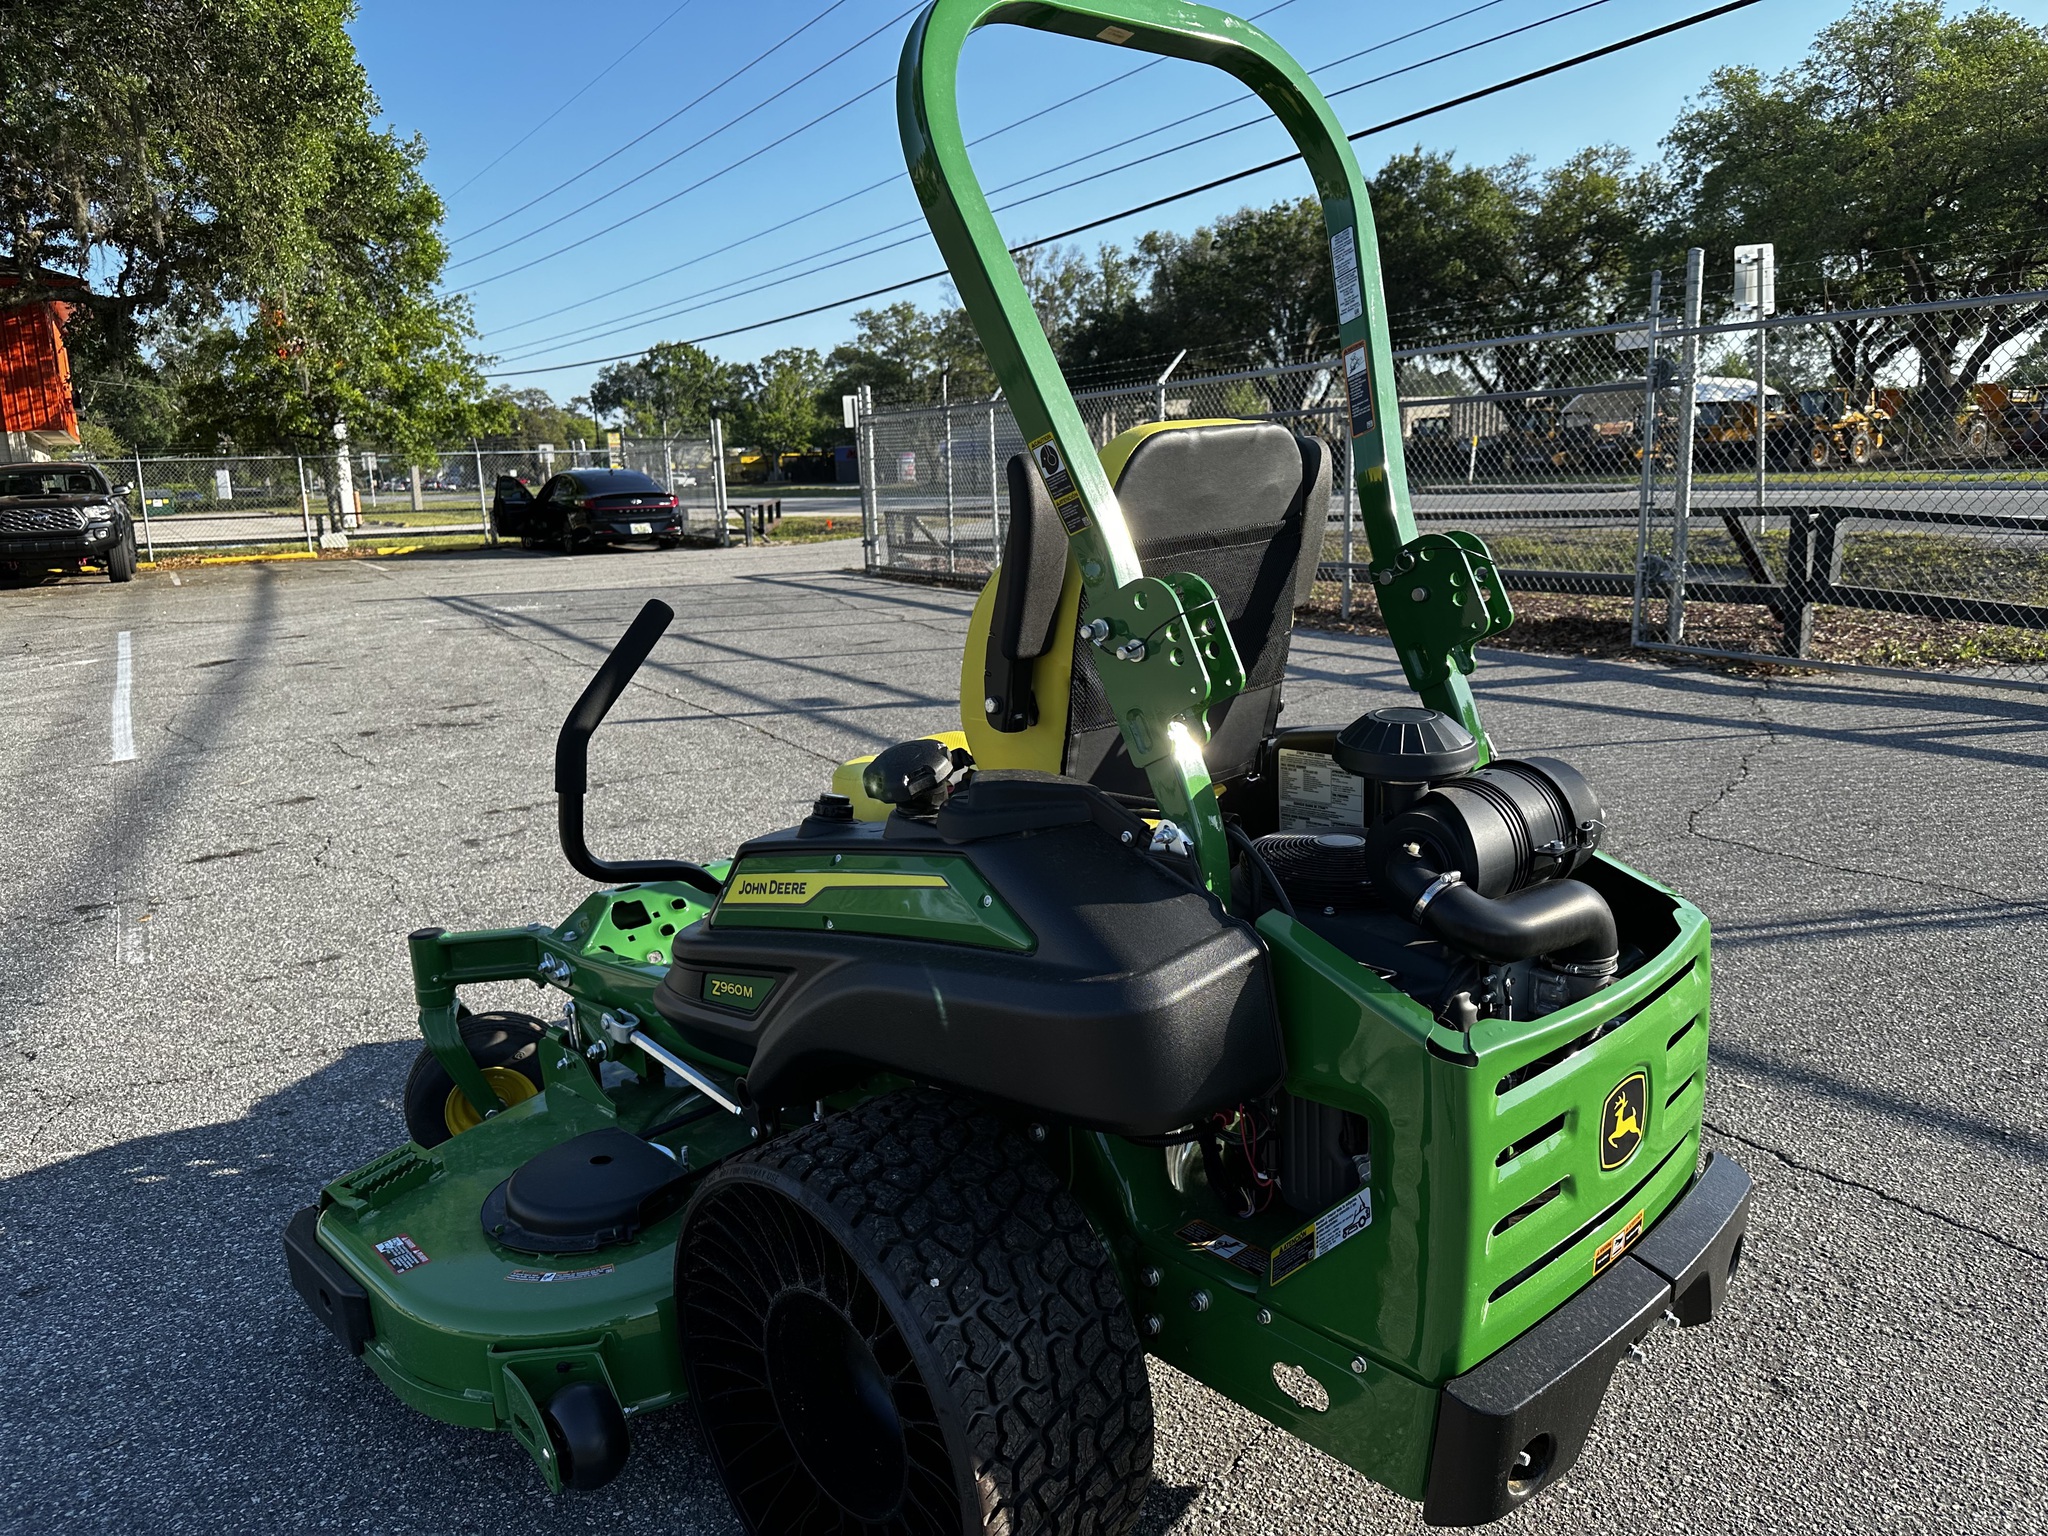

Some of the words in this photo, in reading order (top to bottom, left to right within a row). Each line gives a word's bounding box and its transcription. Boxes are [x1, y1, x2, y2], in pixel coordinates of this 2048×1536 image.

[738, 880, 767, 895] JOHN
[769, 880, 807, 895] DEERE
[711, 980, 753, 998] Z960M
[1284, 1230, 1307, 1250] ATENCIÓN
